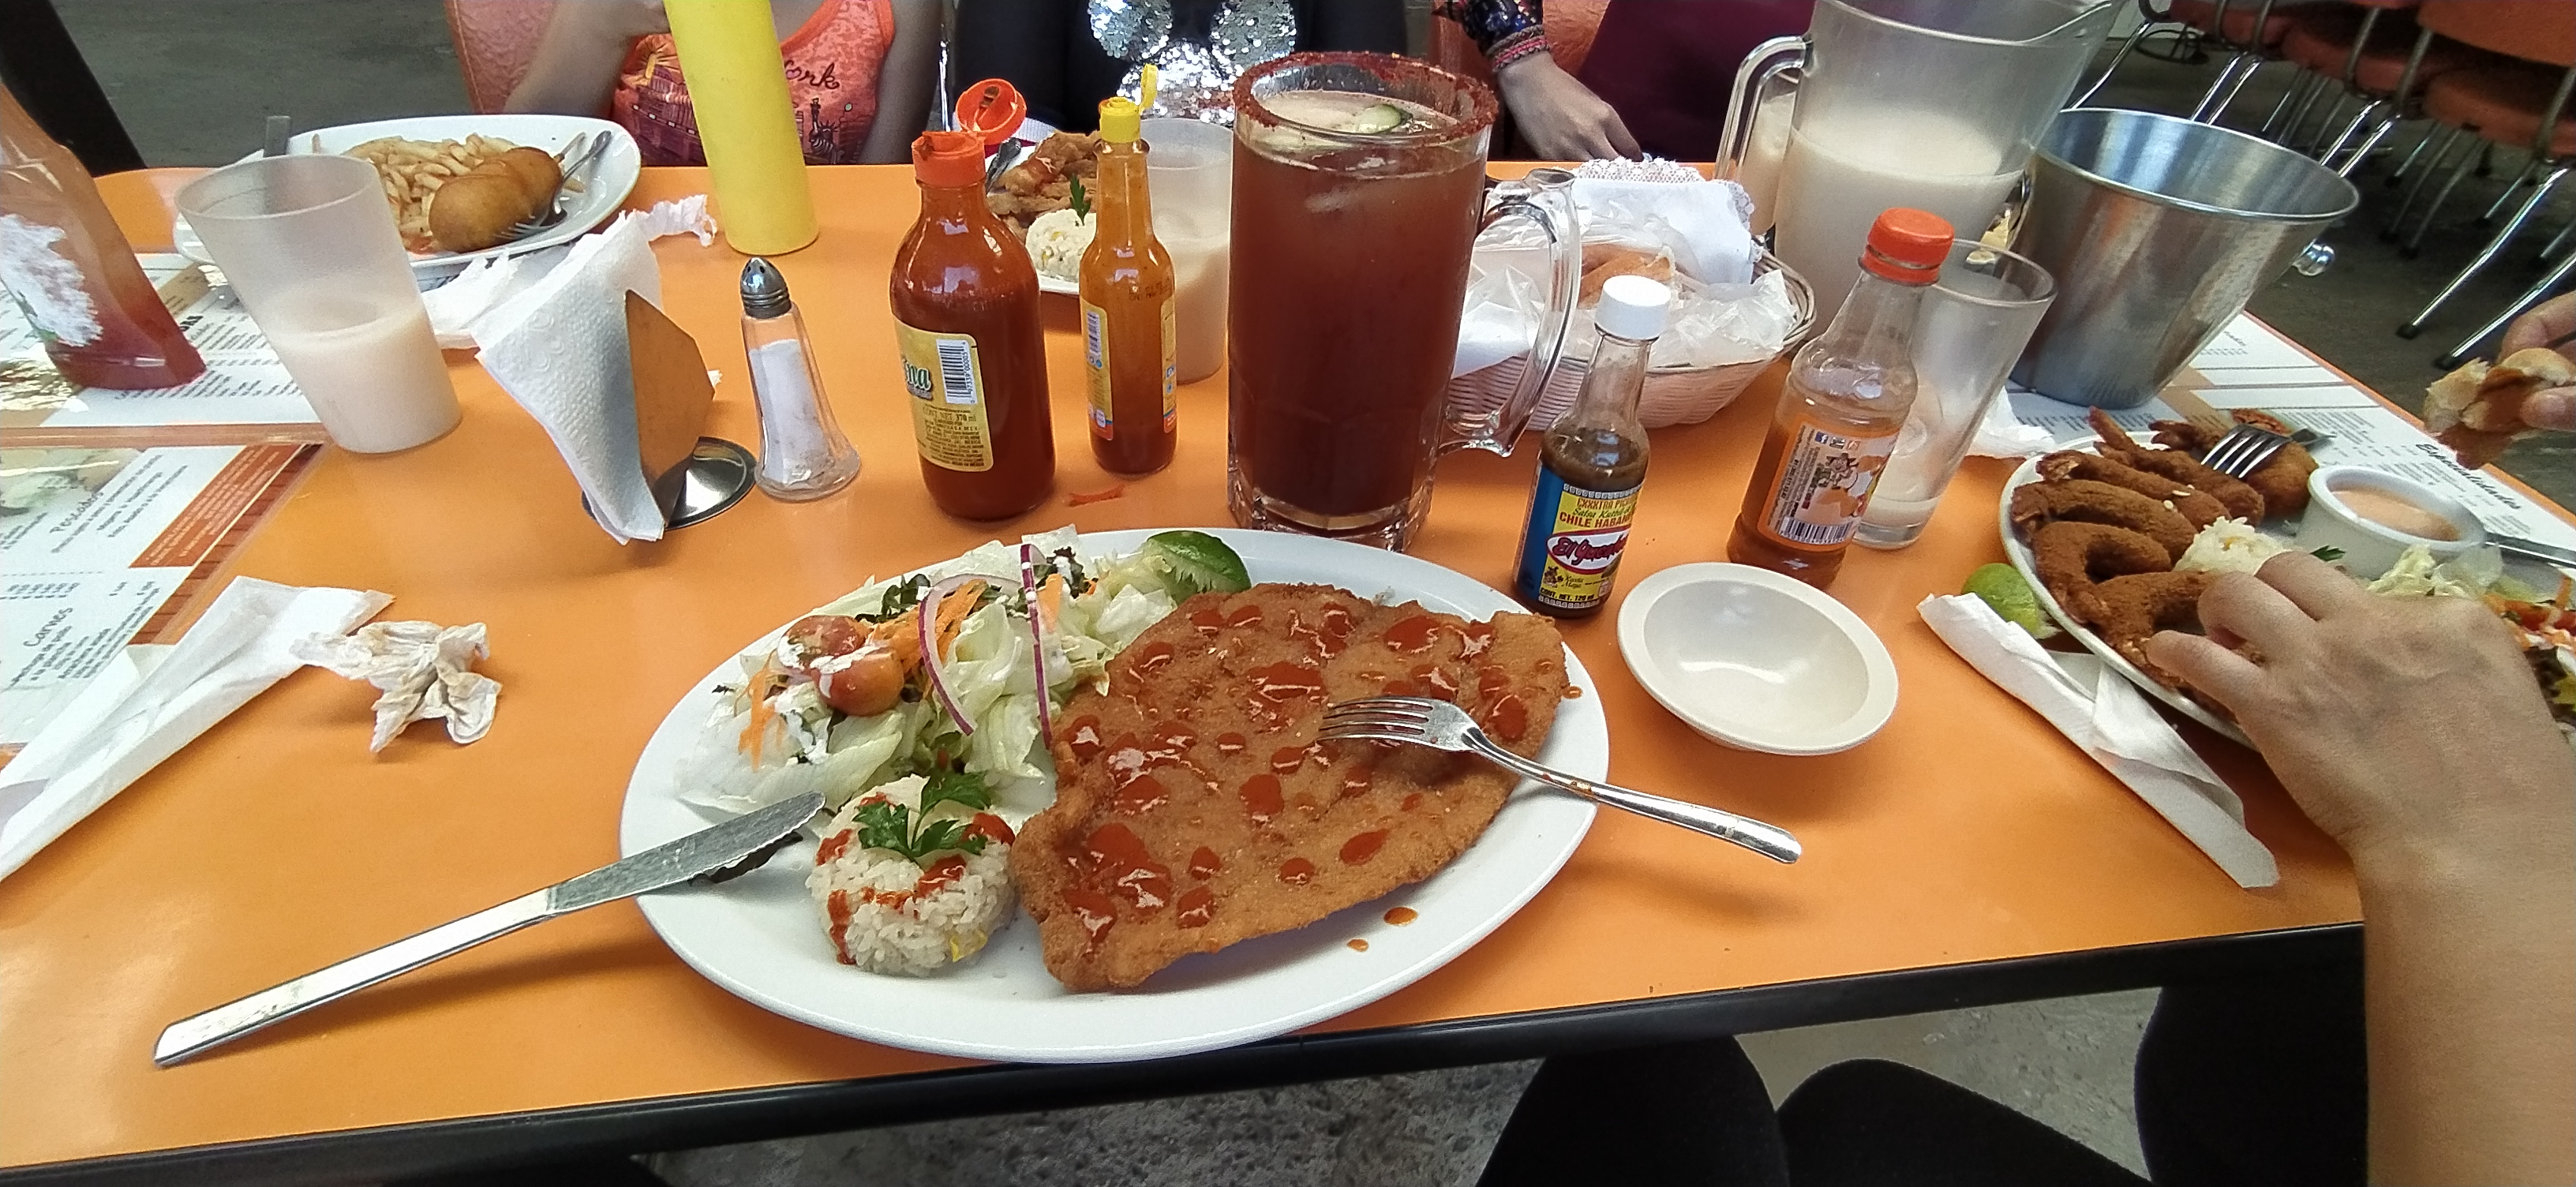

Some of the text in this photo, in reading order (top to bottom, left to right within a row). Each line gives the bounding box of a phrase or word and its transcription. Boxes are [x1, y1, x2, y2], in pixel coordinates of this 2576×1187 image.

[784, 60, 840, 89] ork
[2415, 444, 2522, 509] Especialidades
[50, 492, 103, 533] Pescados
[1559, 511, 1592, 527] CHILE
[1573, 507, 1597, 518] Salsa
[23, 608, 73, 646] Carnes
[11, 653, 47, 682] Pechuga
[51, 626, 72, 642] pollo
[42, 642, 72, 667] plancha
[58, 648, 93, 679] Arrachera
[90, 628, 111, 646] asada
